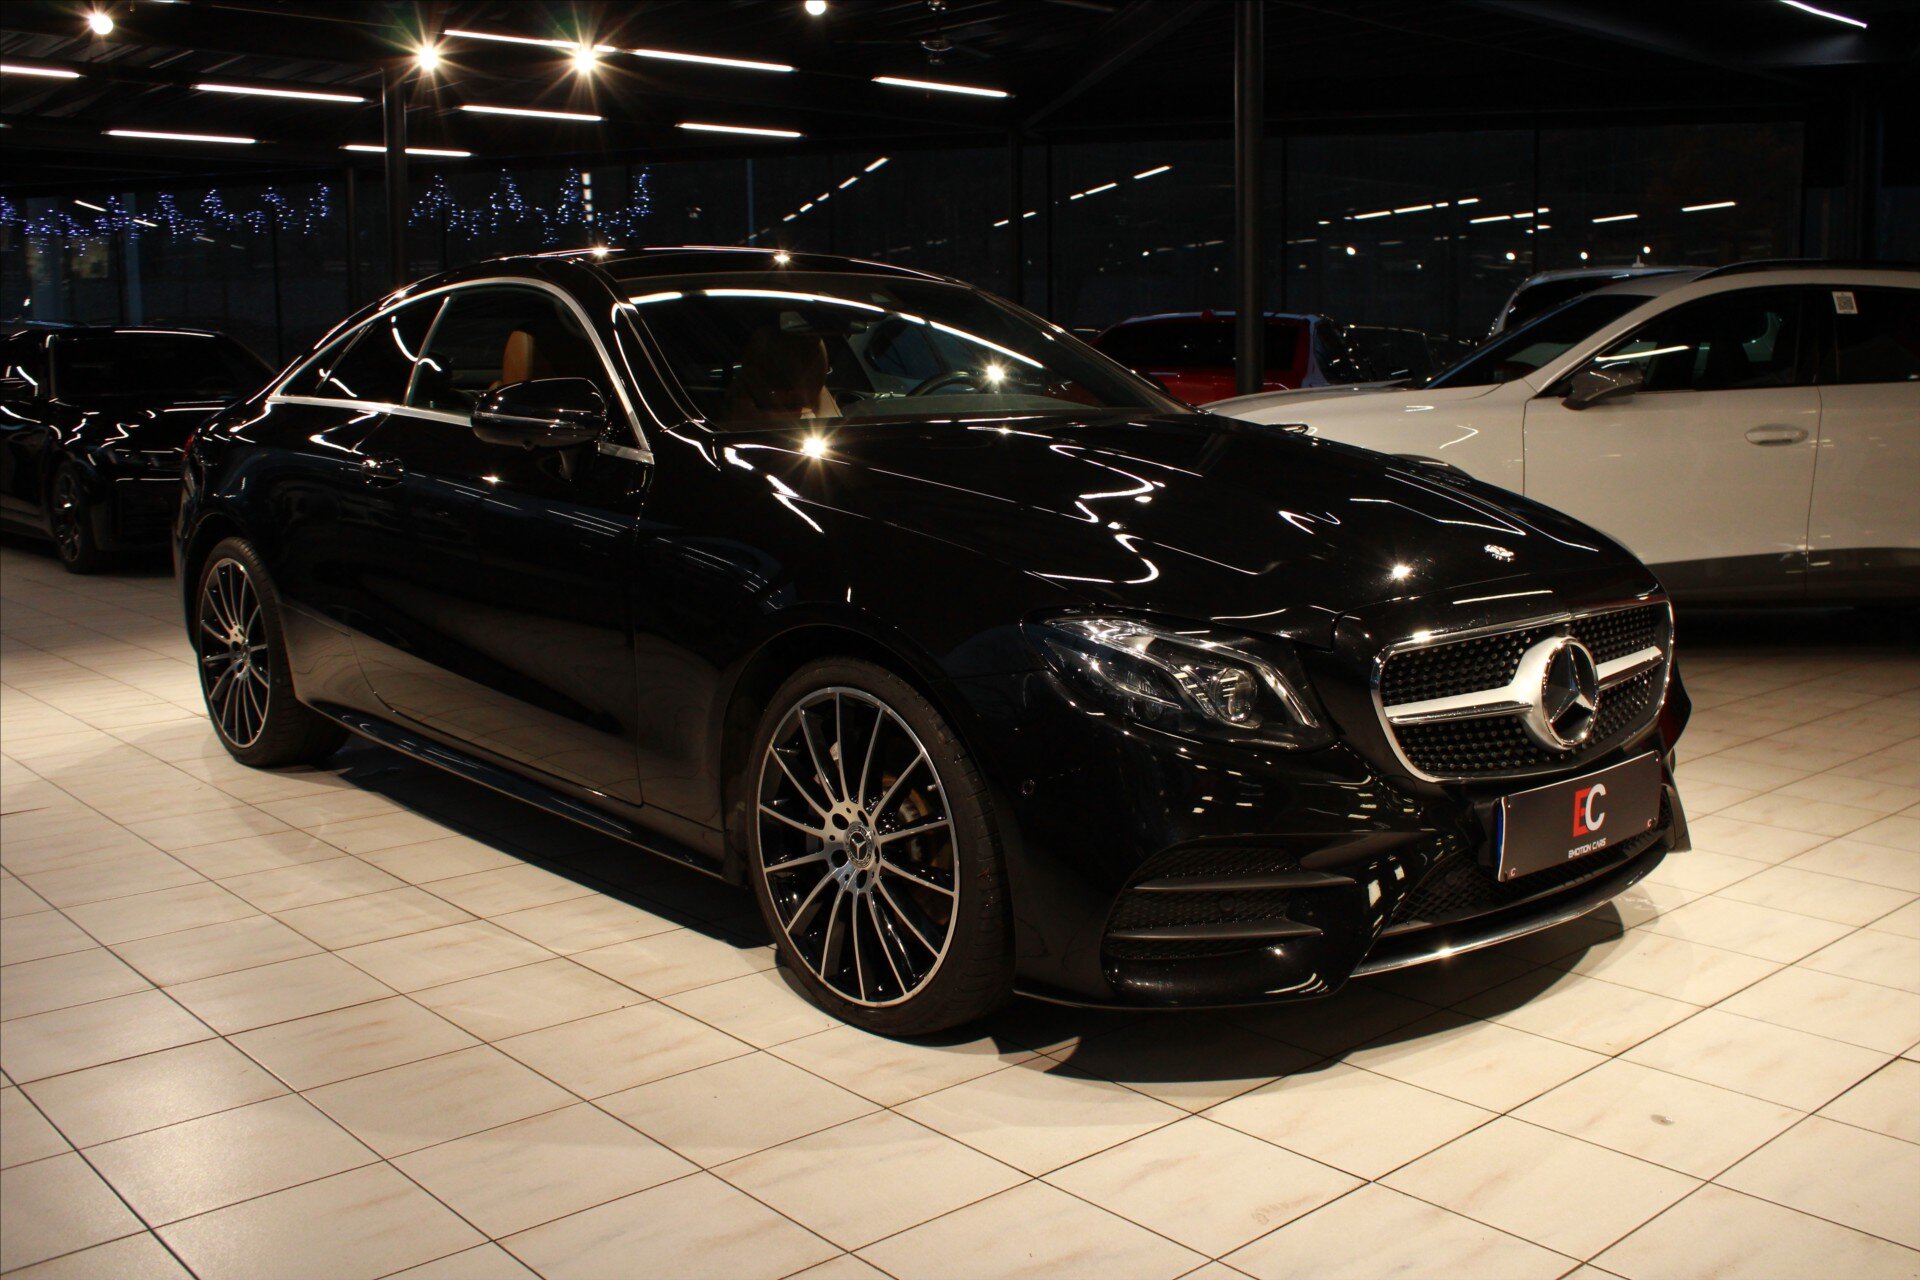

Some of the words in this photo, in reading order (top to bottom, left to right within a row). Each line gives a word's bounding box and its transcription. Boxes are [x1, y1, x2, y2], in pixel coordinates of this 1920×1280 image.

[1572, 783, 1607, 837] EC
[1568, 843, 1592, 859] EMOTION
[1592, 838, 1607, 850] CARS
